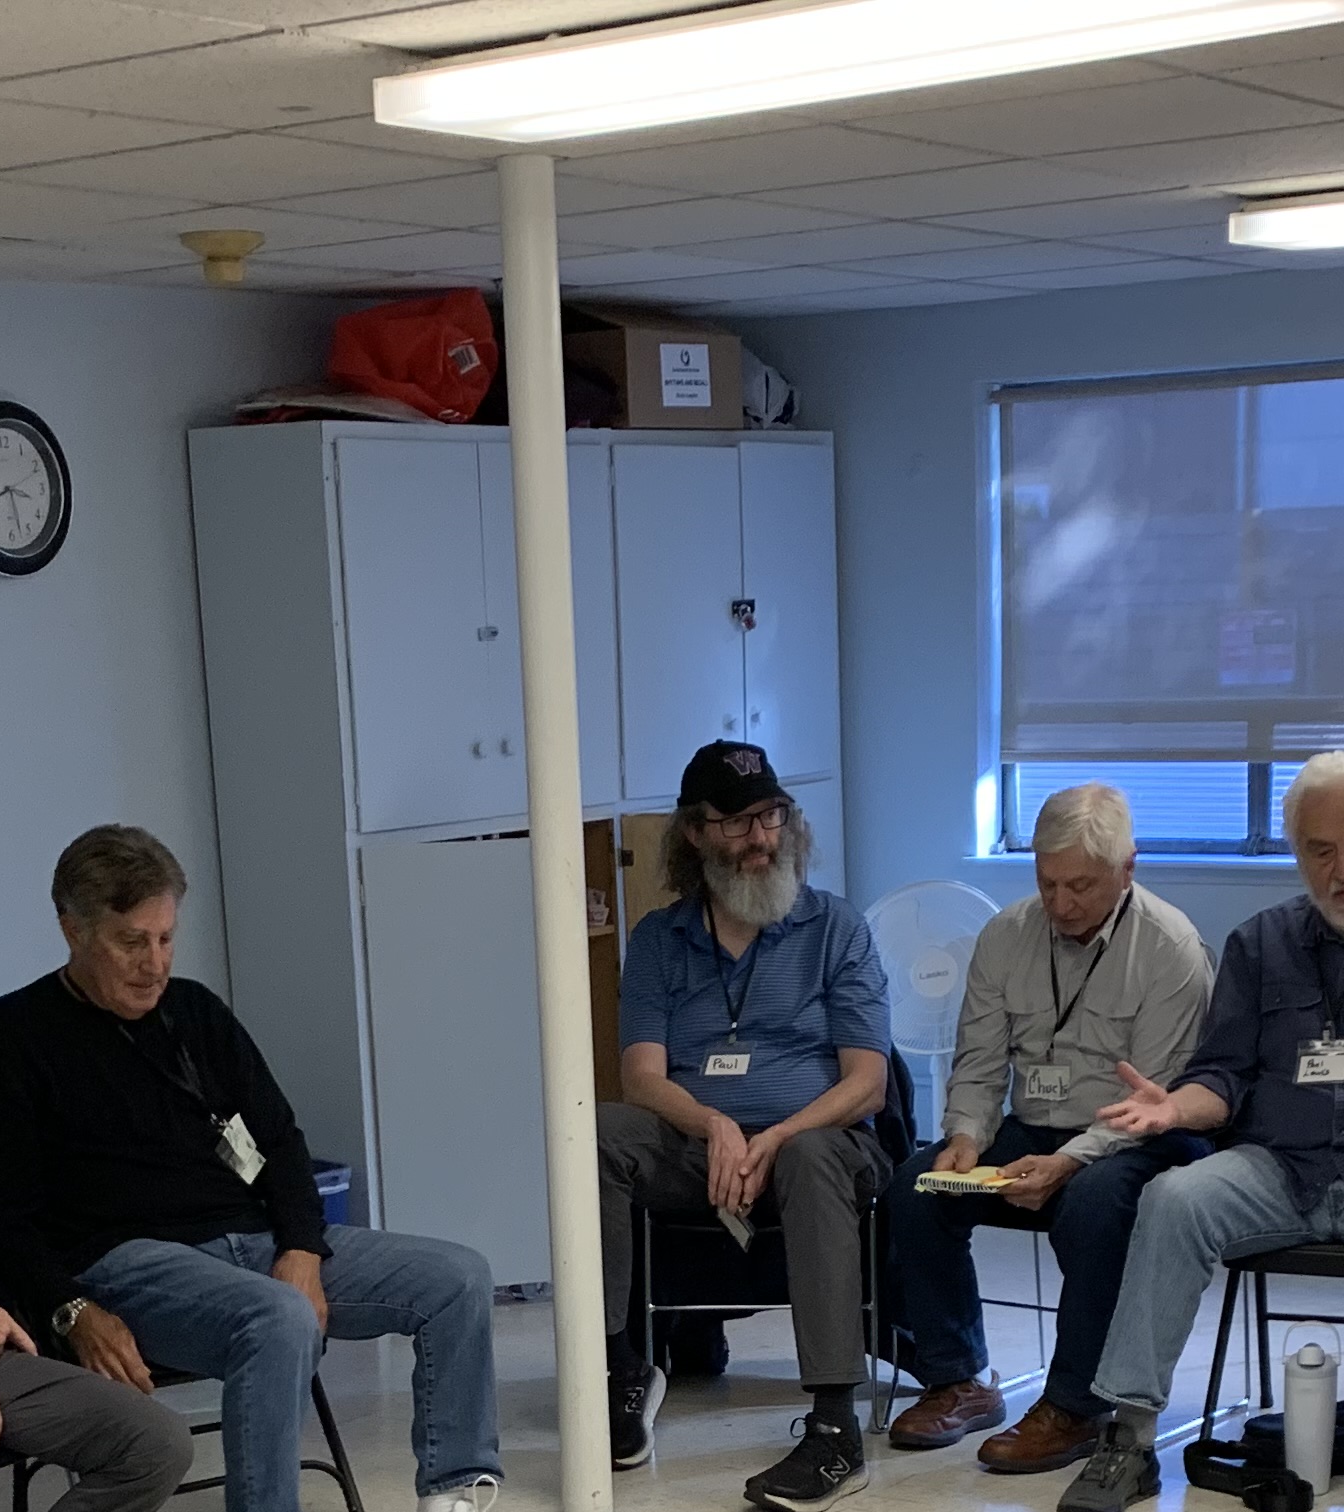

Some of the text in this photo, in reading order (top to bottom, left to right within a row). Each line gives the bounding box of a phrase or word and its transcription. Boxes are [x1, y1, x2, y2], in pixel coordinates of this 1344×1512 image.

[0, 435, 10, 449] 12
[18, 443, 24, 456] 1
[31, 459, 40, 473] 2
[39, 483, 45, 496] 3
[34, 508, 41, 521] 4
[8, 529, 16, 541] 6
[25, 522, 32, 535] 5
[723, 750, 762, 776] W
[712, 1057, 739, 1070] Paul
